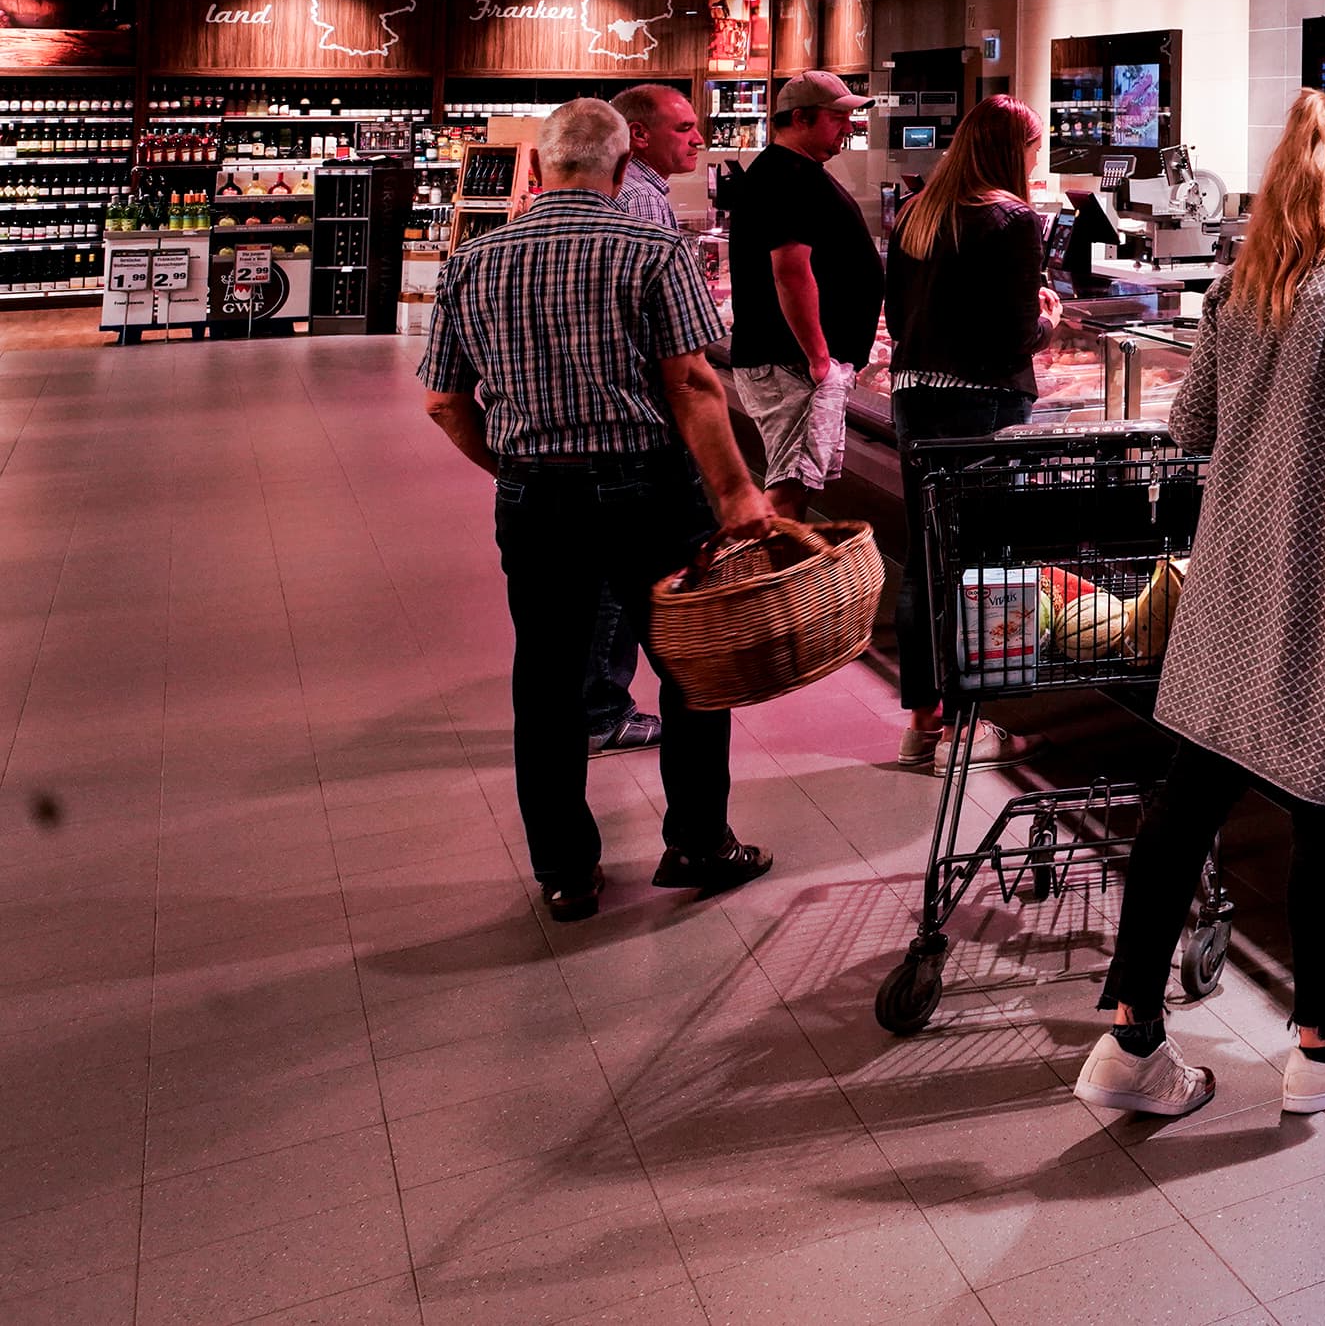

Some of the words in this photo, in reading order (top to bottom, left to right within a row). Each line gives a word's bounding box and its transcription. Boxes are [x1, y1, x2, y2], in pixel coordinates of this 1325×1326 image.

[206, 4, 272, 24] land
[222, 301, 265, 314] GWF
[989, 592, 1017, 606] Vitlis
